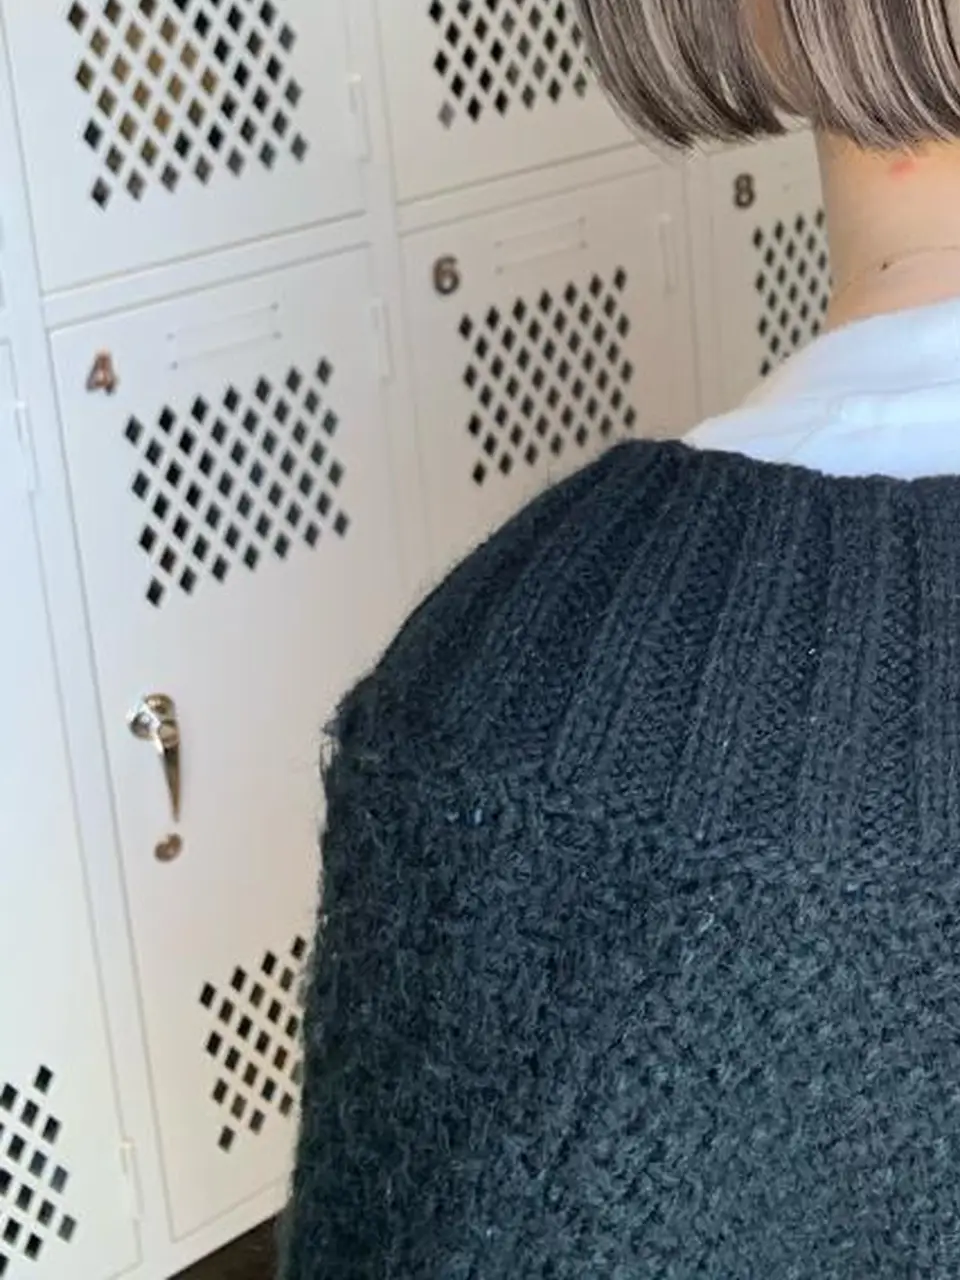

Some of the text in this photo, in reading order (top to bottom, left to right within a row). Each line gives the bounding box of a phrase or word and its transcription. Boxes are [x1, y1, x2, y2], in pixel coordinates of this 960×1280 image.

[733, 173, 755, 209] 8
[432, 255, 460, 296] 6
[87, 352, 119, 395] 4
